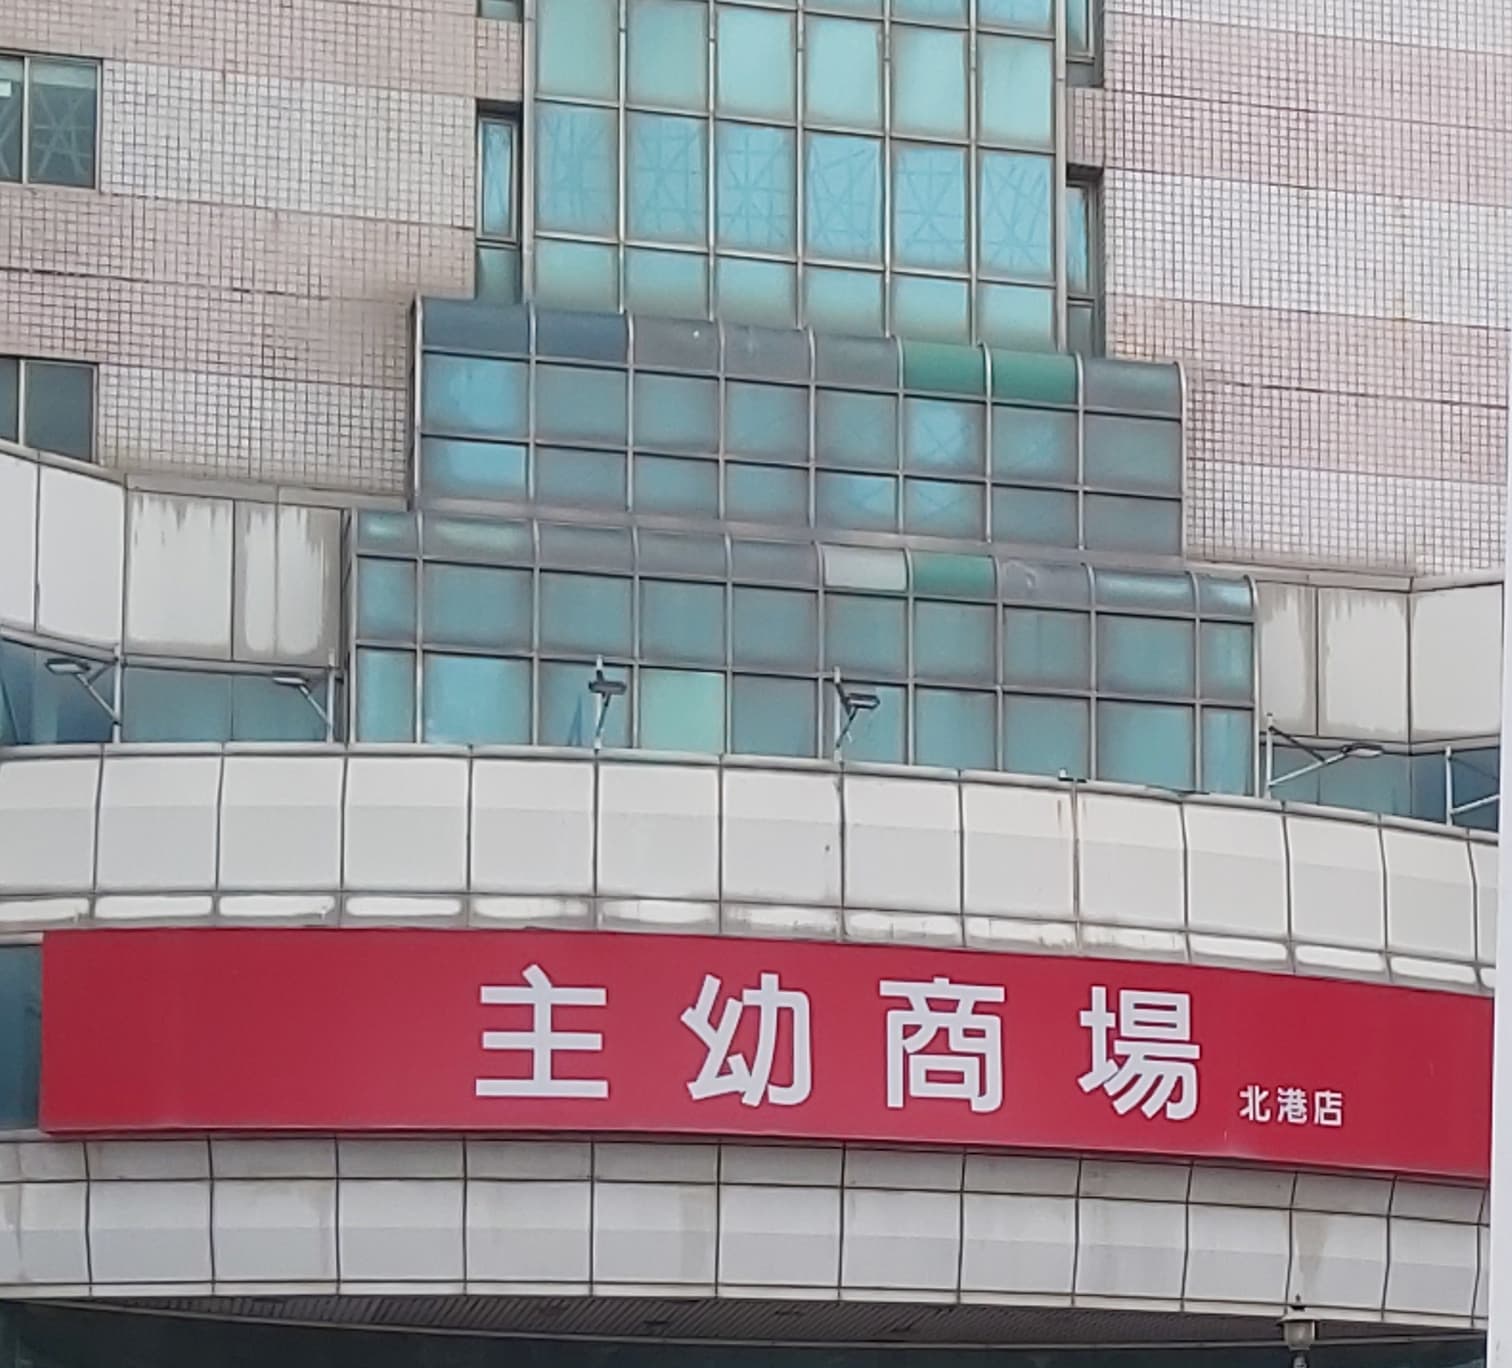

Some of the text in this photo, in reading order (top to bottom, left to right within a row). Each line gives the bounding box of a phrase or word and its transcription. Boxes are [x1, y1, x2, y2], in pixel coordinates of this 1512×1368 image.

[475, 963, 1201, 1121] 主幼商場
[1239, 1086, 1344, 1127] 北港店
